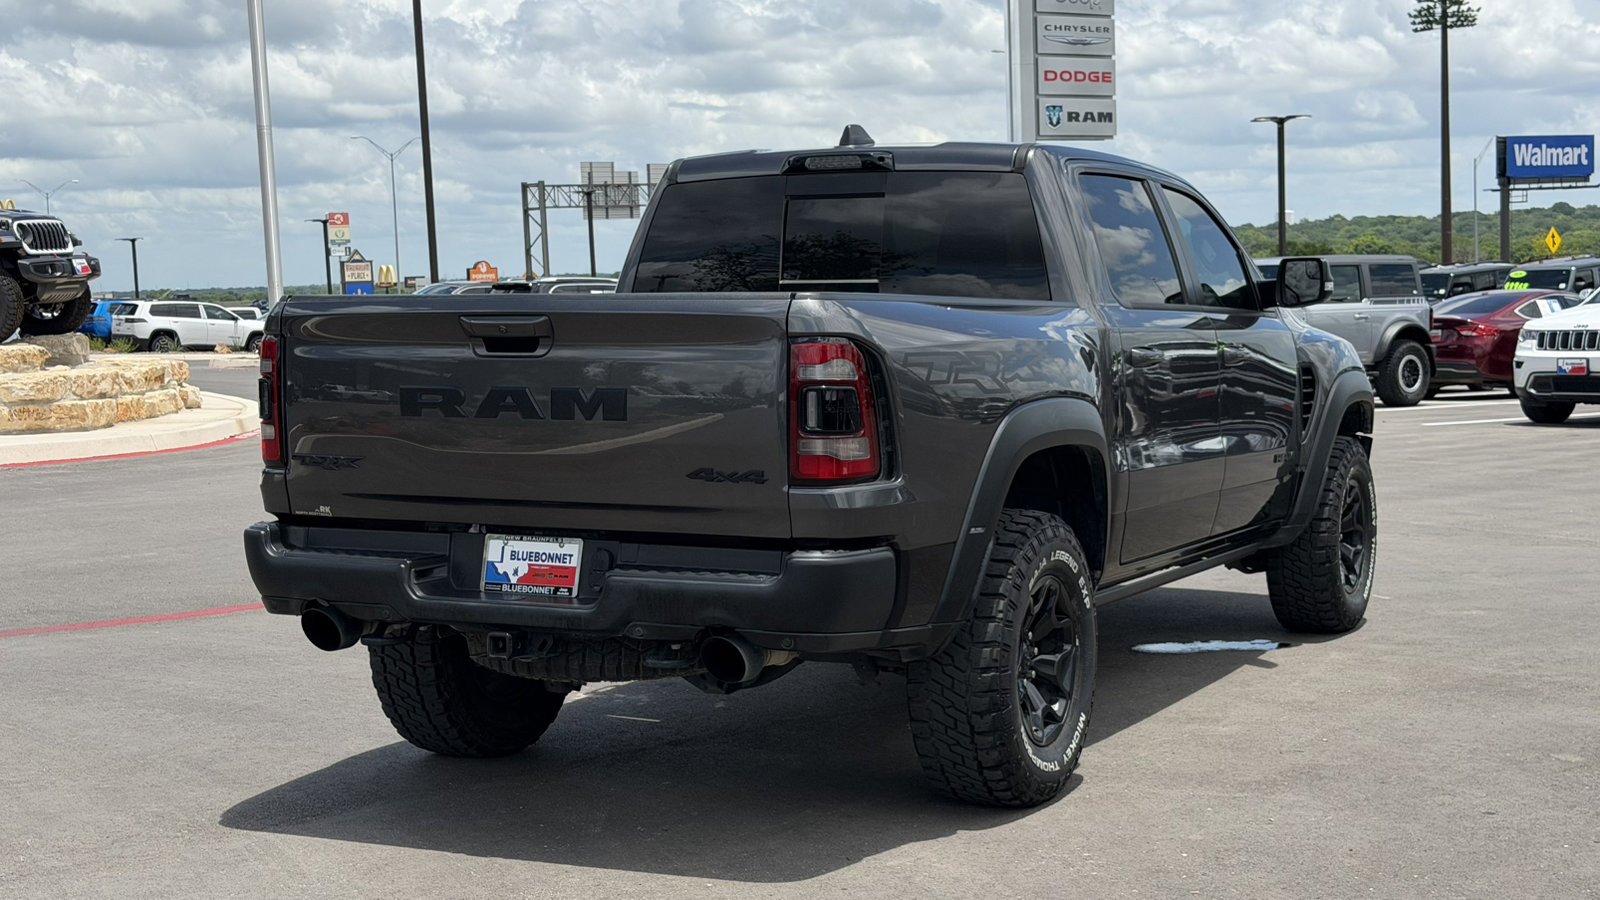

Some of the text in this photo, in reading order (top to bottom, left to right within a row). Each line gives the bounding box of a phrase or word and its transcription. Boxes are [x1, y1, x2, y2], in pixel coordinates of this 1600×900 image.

[1044, 24, 1110, 33] CHRYSLER
[1043, 70, 1113, 83] DODGE
[1066, 111, 1113, 123] RAM
[1513, 143, 1588, 167] Walmart
[399, 385, 628, 421] RAM
[685, 467, 769, 485] 4x4
[510, 550, 574, 565] BLUEBONNET
[1050, 550, 1079, 574] LEGEND
[1078, 576, 1091, 609] EXP
[501, 583, 555, 595] BLUEBONNET
[1020, 712, 1087, 772] MICKEY THOMPSON
